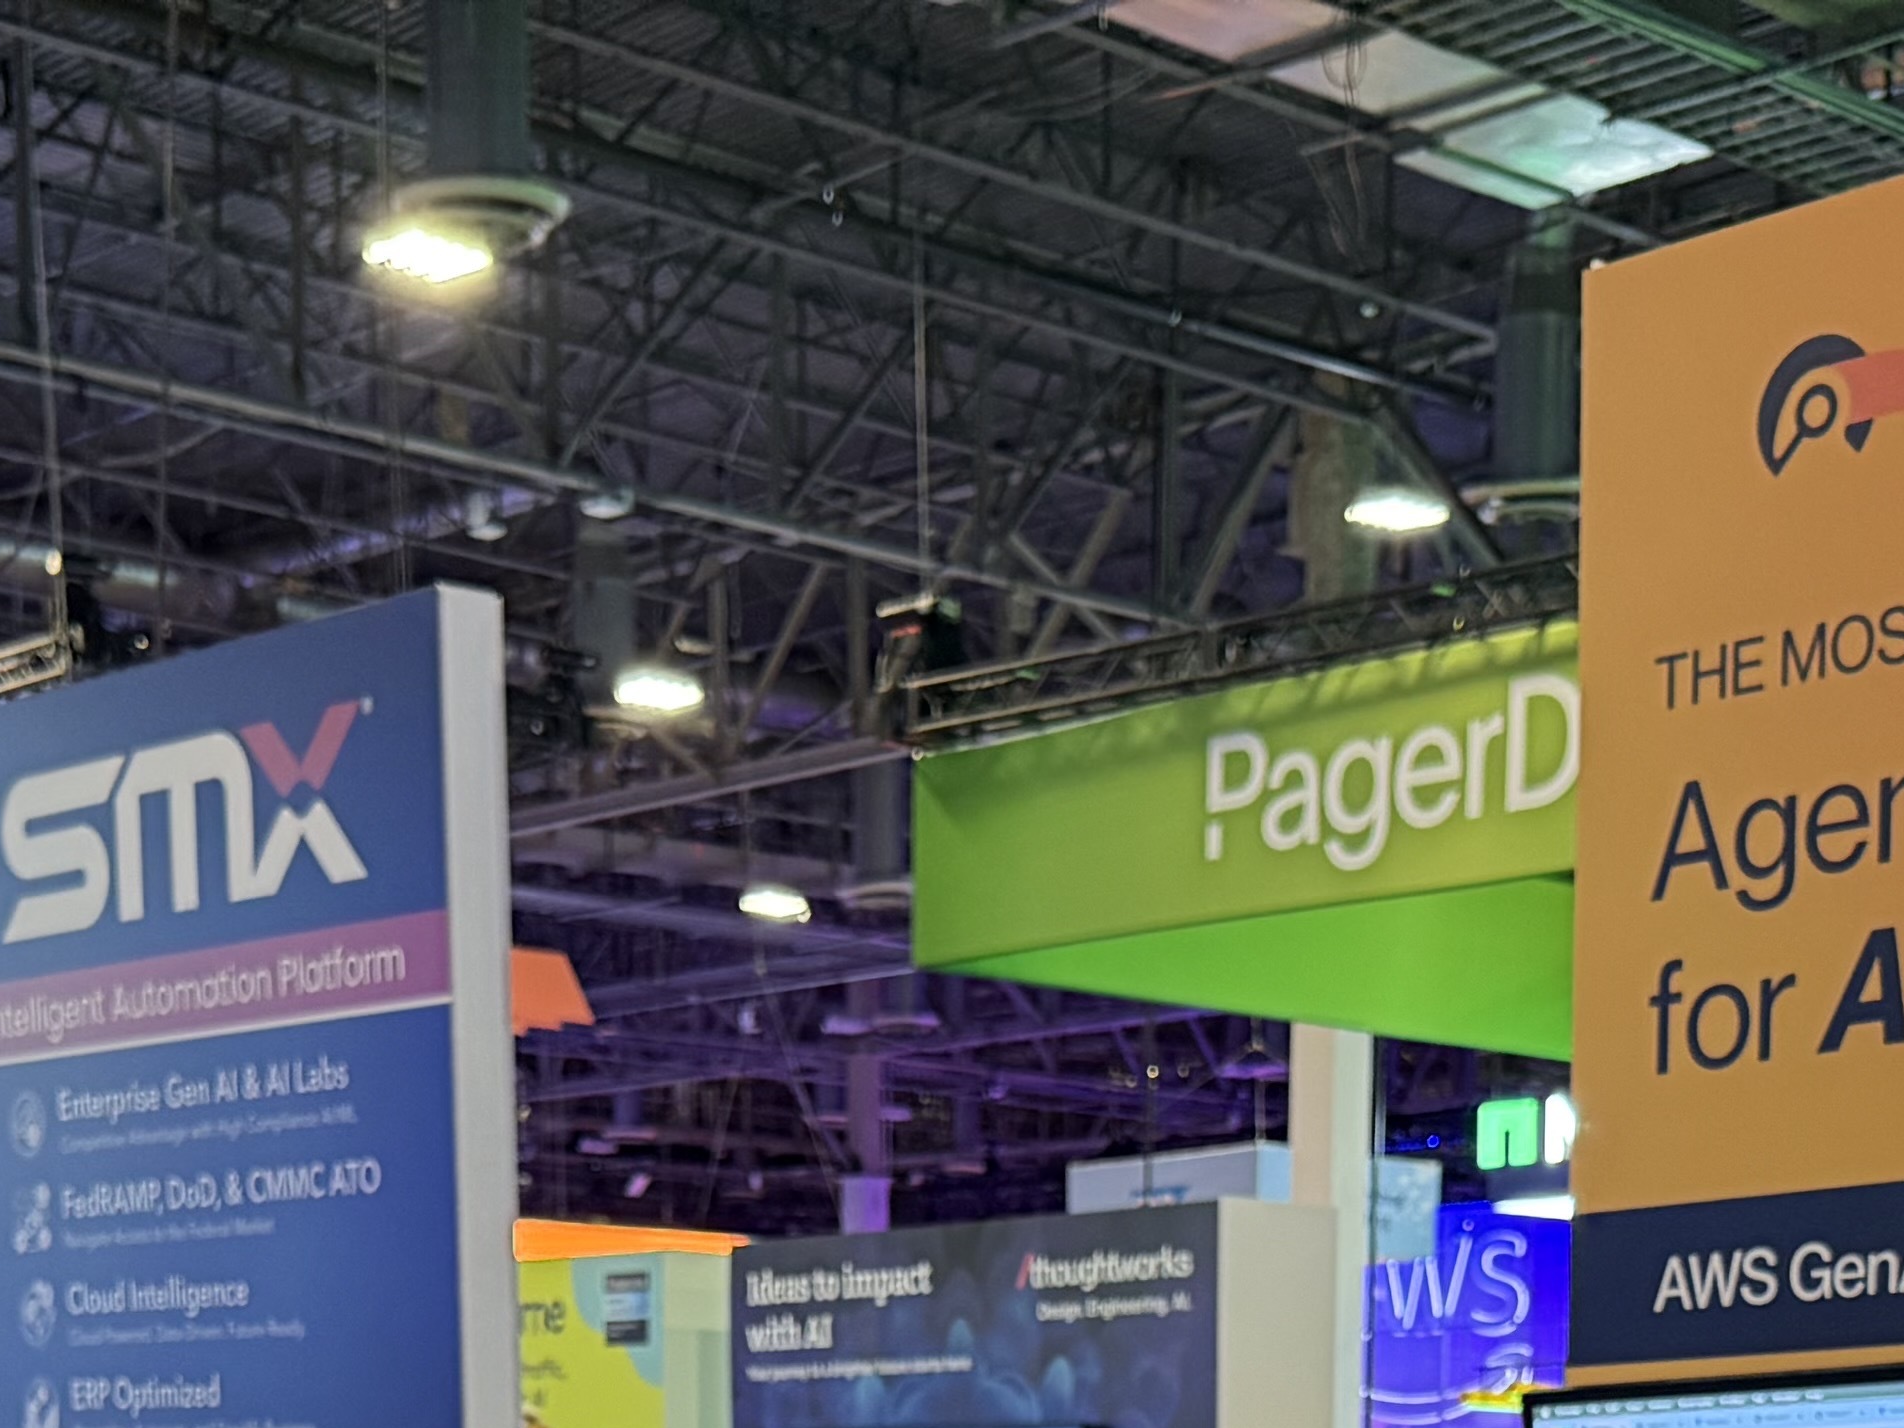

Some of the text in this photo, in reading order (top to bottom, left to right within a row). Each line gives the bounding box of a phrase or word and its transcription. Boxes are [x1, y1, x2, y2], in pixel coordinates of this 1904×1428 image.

[1655, 634, 1765, 711] THE
[1204, 674, 1580, 871] PagerD
[1, 700, 369, 945] SMX
[112, 962, 272, 1022] Automation
[278, 941, 406, 996] Platform
[1648, 957, 1796, 1076] for
[56, 1076, 161, 1125] Enterprise
[164, 1072, 210, 1109] Gen
[215, 1067, 239, 1101] AI
[265, 1061, 292, 1097] AI
[295, 1055, 351, 1093] Labs
[247, 1160, 326, 1204] CMMC
[328, 1156, 383, 1198] ATO
[65, 1274, 249, 1318] Cloud Intelligence
[841, 1260, 934, 1307] impact
[1651, 1245, 1780, 1315] AWS
[69, 1371, 222, 1419] ERP Optimized
